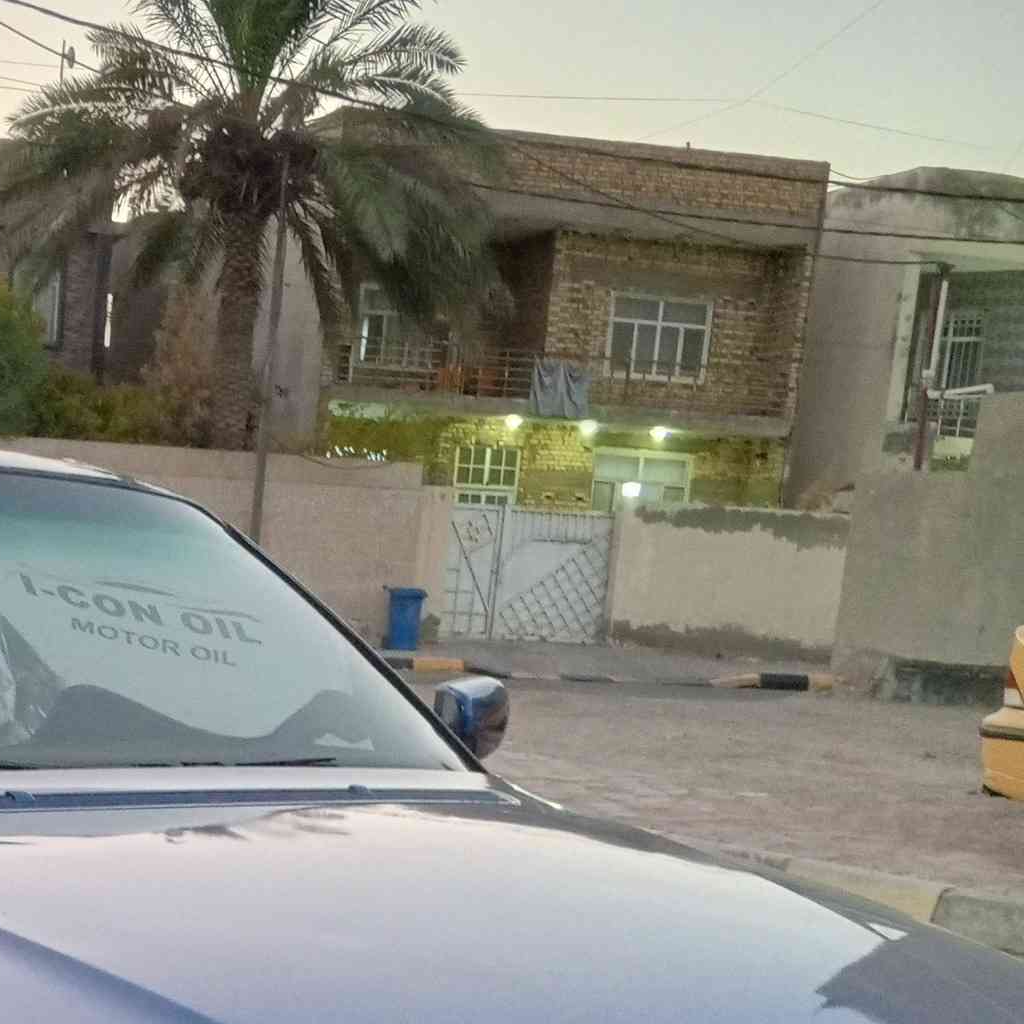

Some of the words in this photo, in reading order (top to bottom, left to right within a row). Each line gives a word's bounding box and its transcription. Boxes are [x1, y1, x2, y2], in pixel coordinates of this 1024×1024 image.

[71, 617, 180, 657] MOTOR
[190, 645, 236, 667] OIL
[180, 611, 262, 645] OIL
